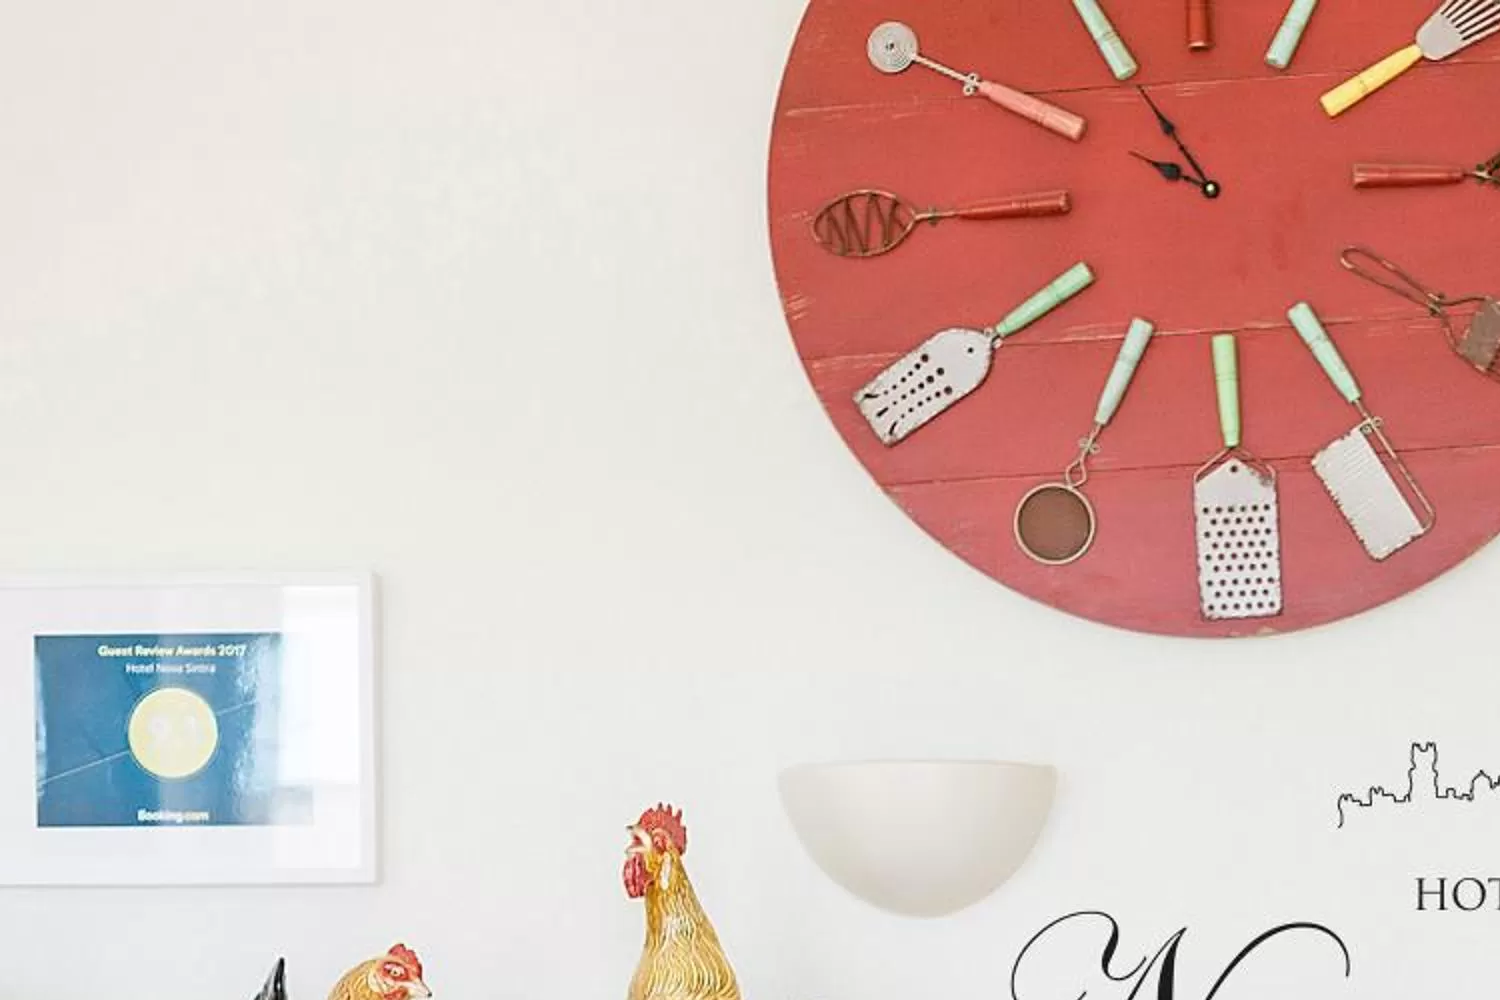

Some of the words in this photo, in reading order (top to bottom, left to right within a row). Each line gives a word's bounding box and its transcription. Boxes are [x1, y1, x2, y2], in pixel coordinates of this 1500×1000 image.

[97, 644, 133, 657] Guest
[135, 644, 174, 657] Review
[175, 644, 216, 657] Awards
[217, 643, 247, 657] 2017
[137, 808, 209, 824] Booking.com
